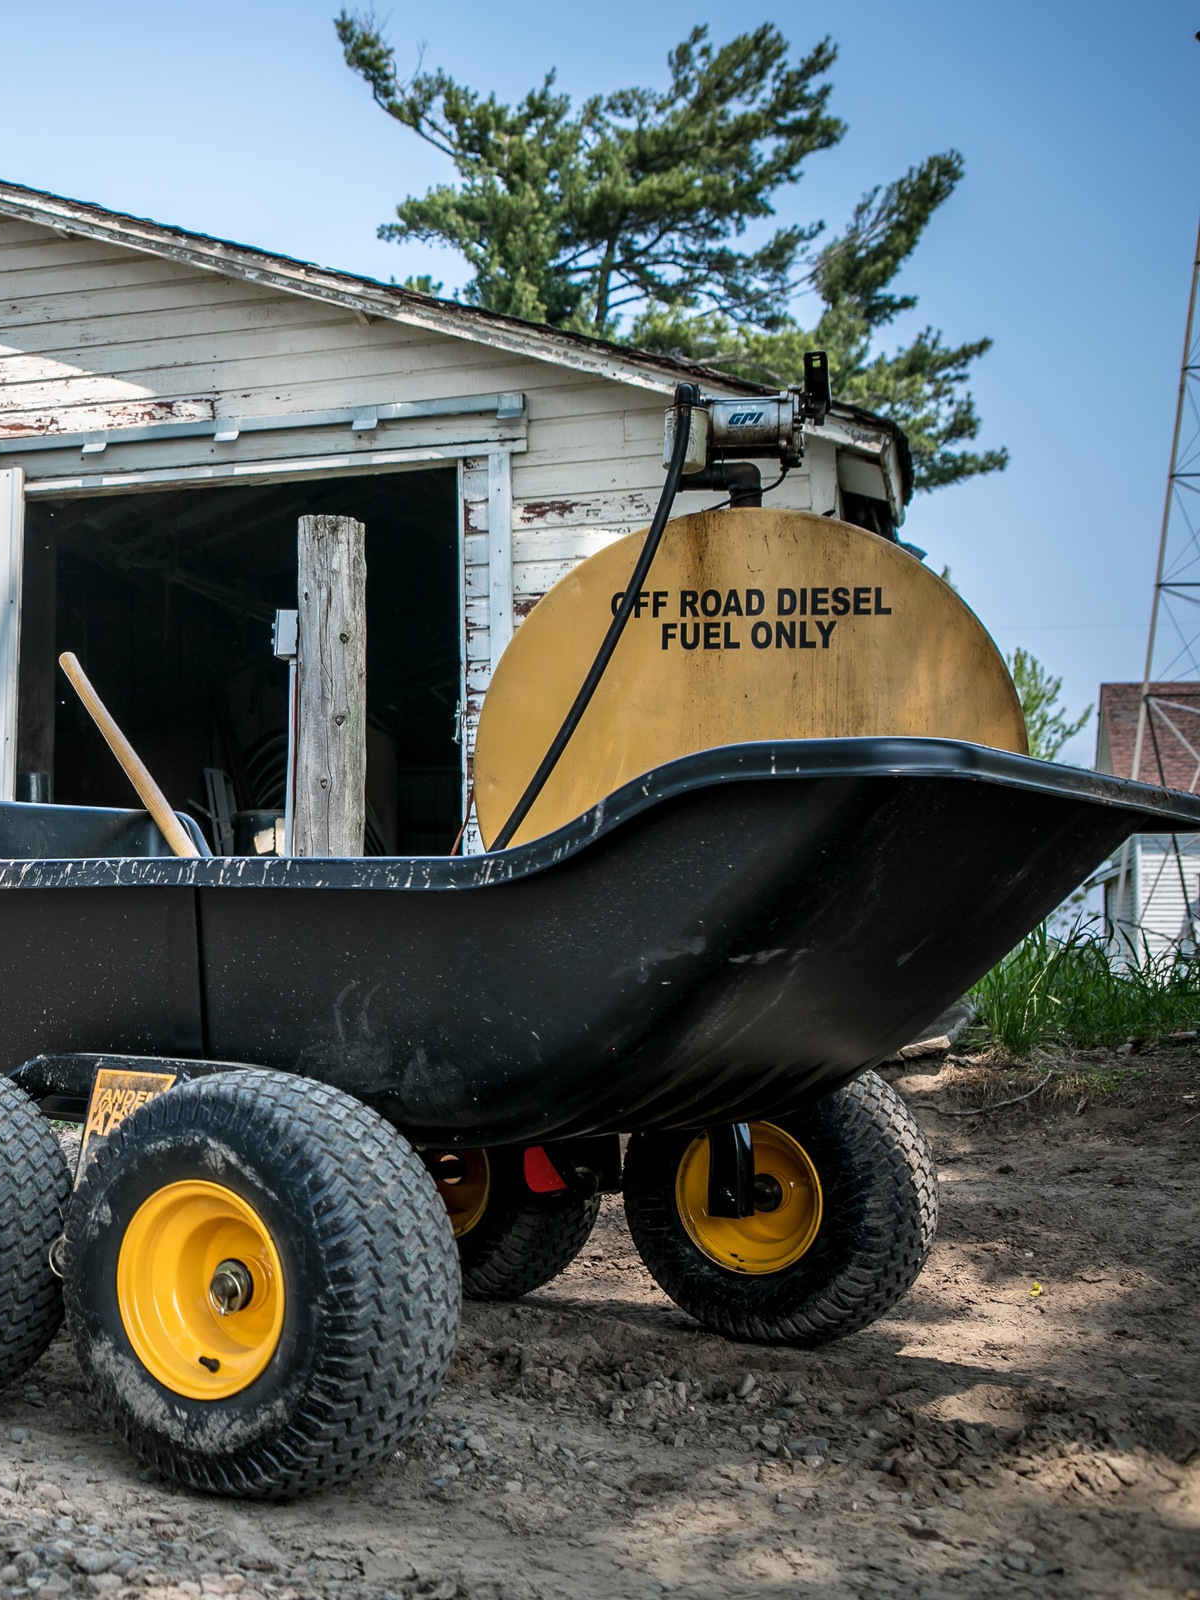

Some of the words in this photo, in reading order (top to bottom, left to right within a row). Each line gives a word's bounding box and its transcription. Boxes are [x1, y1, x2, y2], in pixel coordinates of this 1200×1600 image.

[728, 412, 764, 425] GPI
[611, 591, 669, 618] OFF
[680, 588, 766, 618] ROAD
[776, 586, 892, 616] DIESEL
[661, 622, 741, 650] FUEL
[751, 620, 838, 649] ONLY
